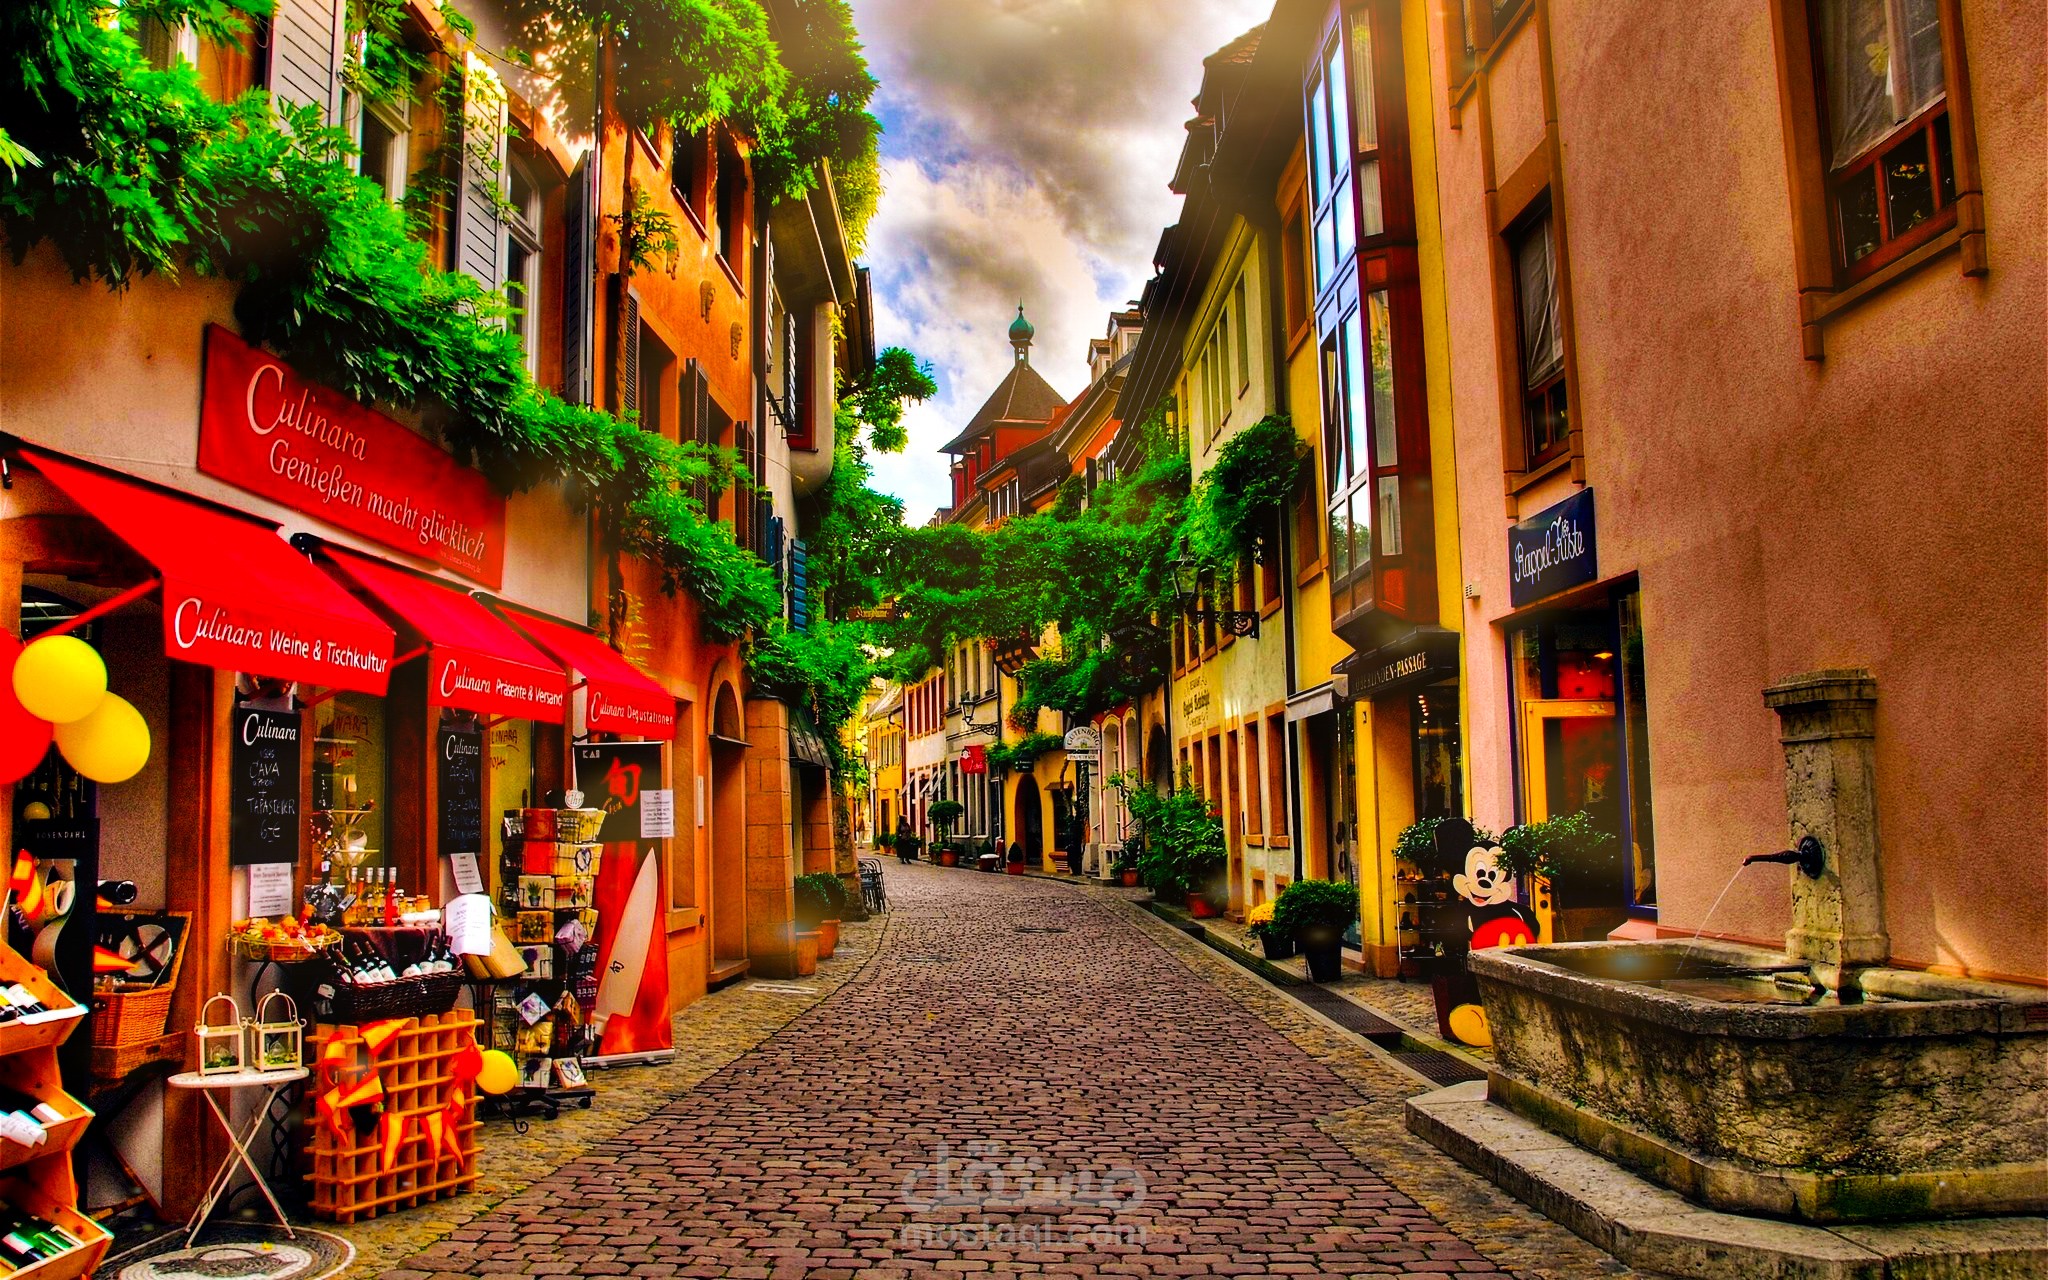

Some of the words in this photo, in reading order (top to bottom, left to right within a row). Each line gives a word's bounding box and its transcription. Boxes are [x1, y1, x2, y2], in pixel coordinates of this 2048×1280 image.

[247, 364, 366, 461] Culinara
[270, 438, 363, 508] Genießen
[367, 491, 418, 530] macht
[419, 509, 485, 560] glücklich
[175, 598, 262, 649] Culinara
[270, 628, 309, 659] Weine
[313, 640, 322, 661] &
[327, 641, 387, 673] Tischkultur
[440, 659, 490, 698] Culinara
[528, 685, 533, 701] &
[535, 688, 563, 706] Versand
[591, 692, 624, 722] Culinara
[627, 705, 673, 724] Degustationen
[243, 713, 297, 746] Culinara
[1067, 728, 1100, 746] GUTENBERG
[445, 734, 479, 760] Culinara
[250, 762, 280, 779] CAVA
